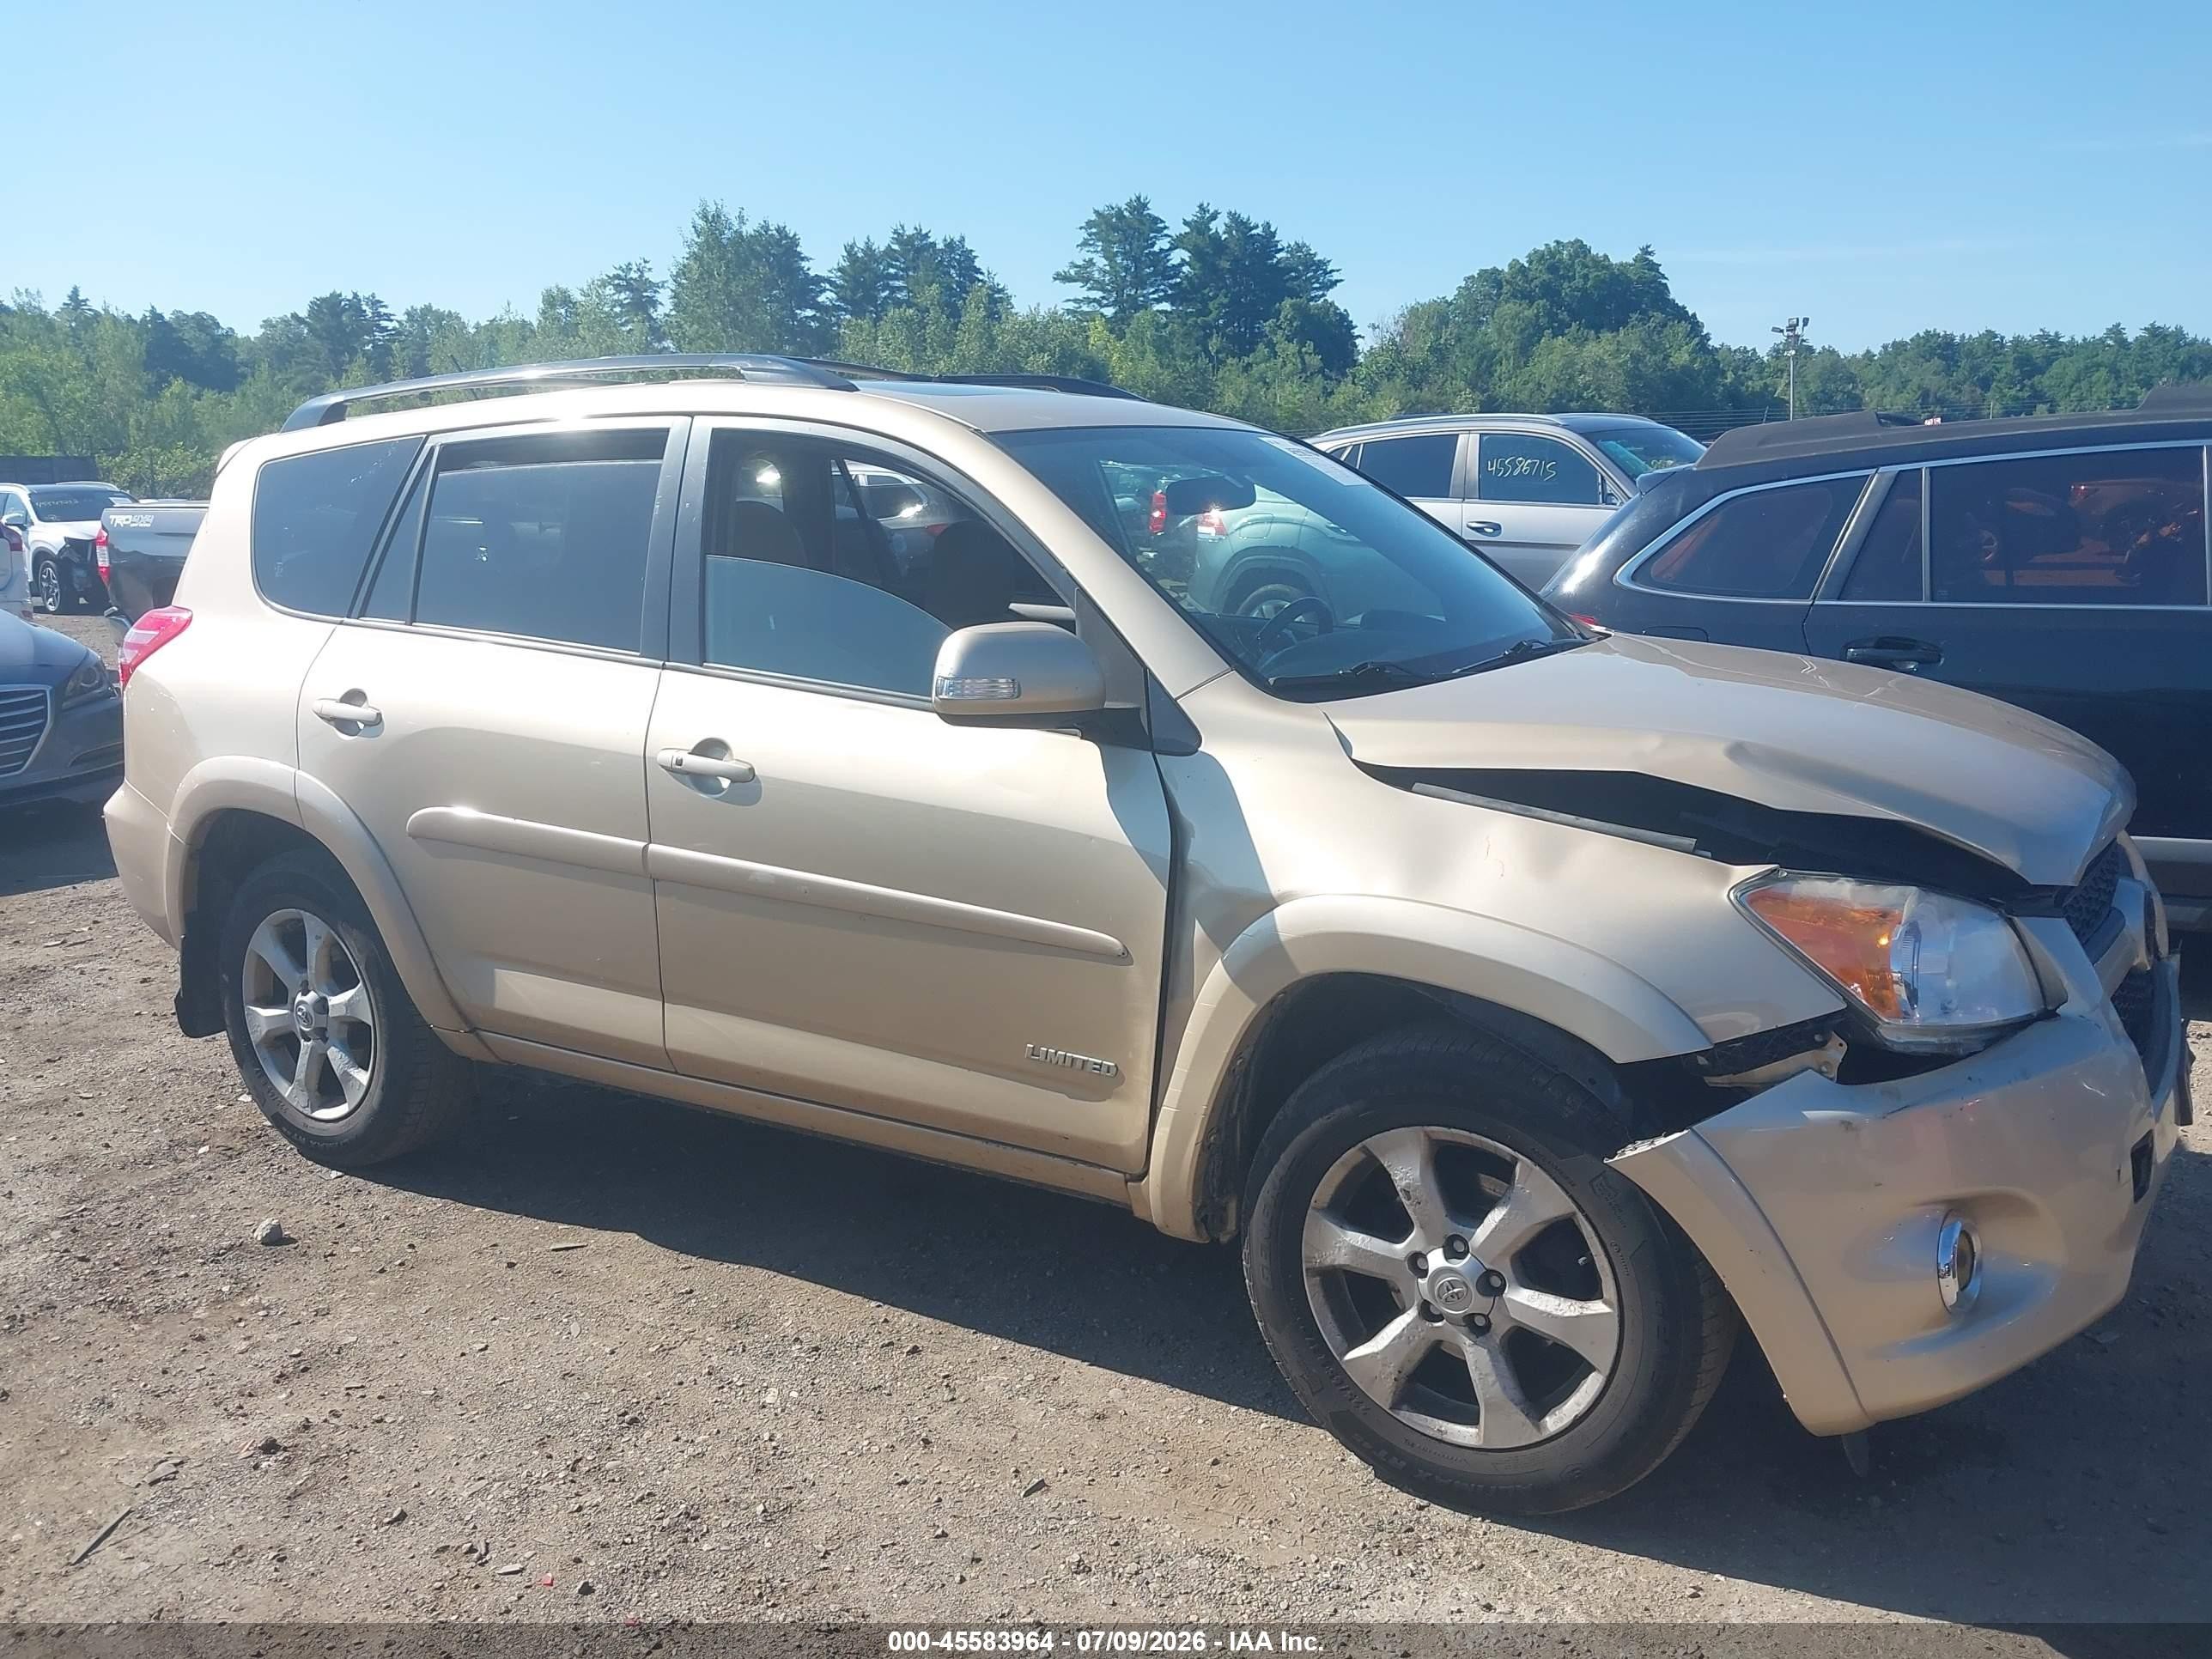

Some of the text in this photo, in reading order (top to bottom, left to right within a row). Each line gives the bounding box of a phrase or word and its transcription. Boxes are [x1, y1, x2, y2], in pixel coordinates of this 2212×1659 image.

[1487, 456, 1557, 482] 45586715
[110, 514, 132, 527] TRD
[1025, 1043, 1119, 1078] LIMITED
